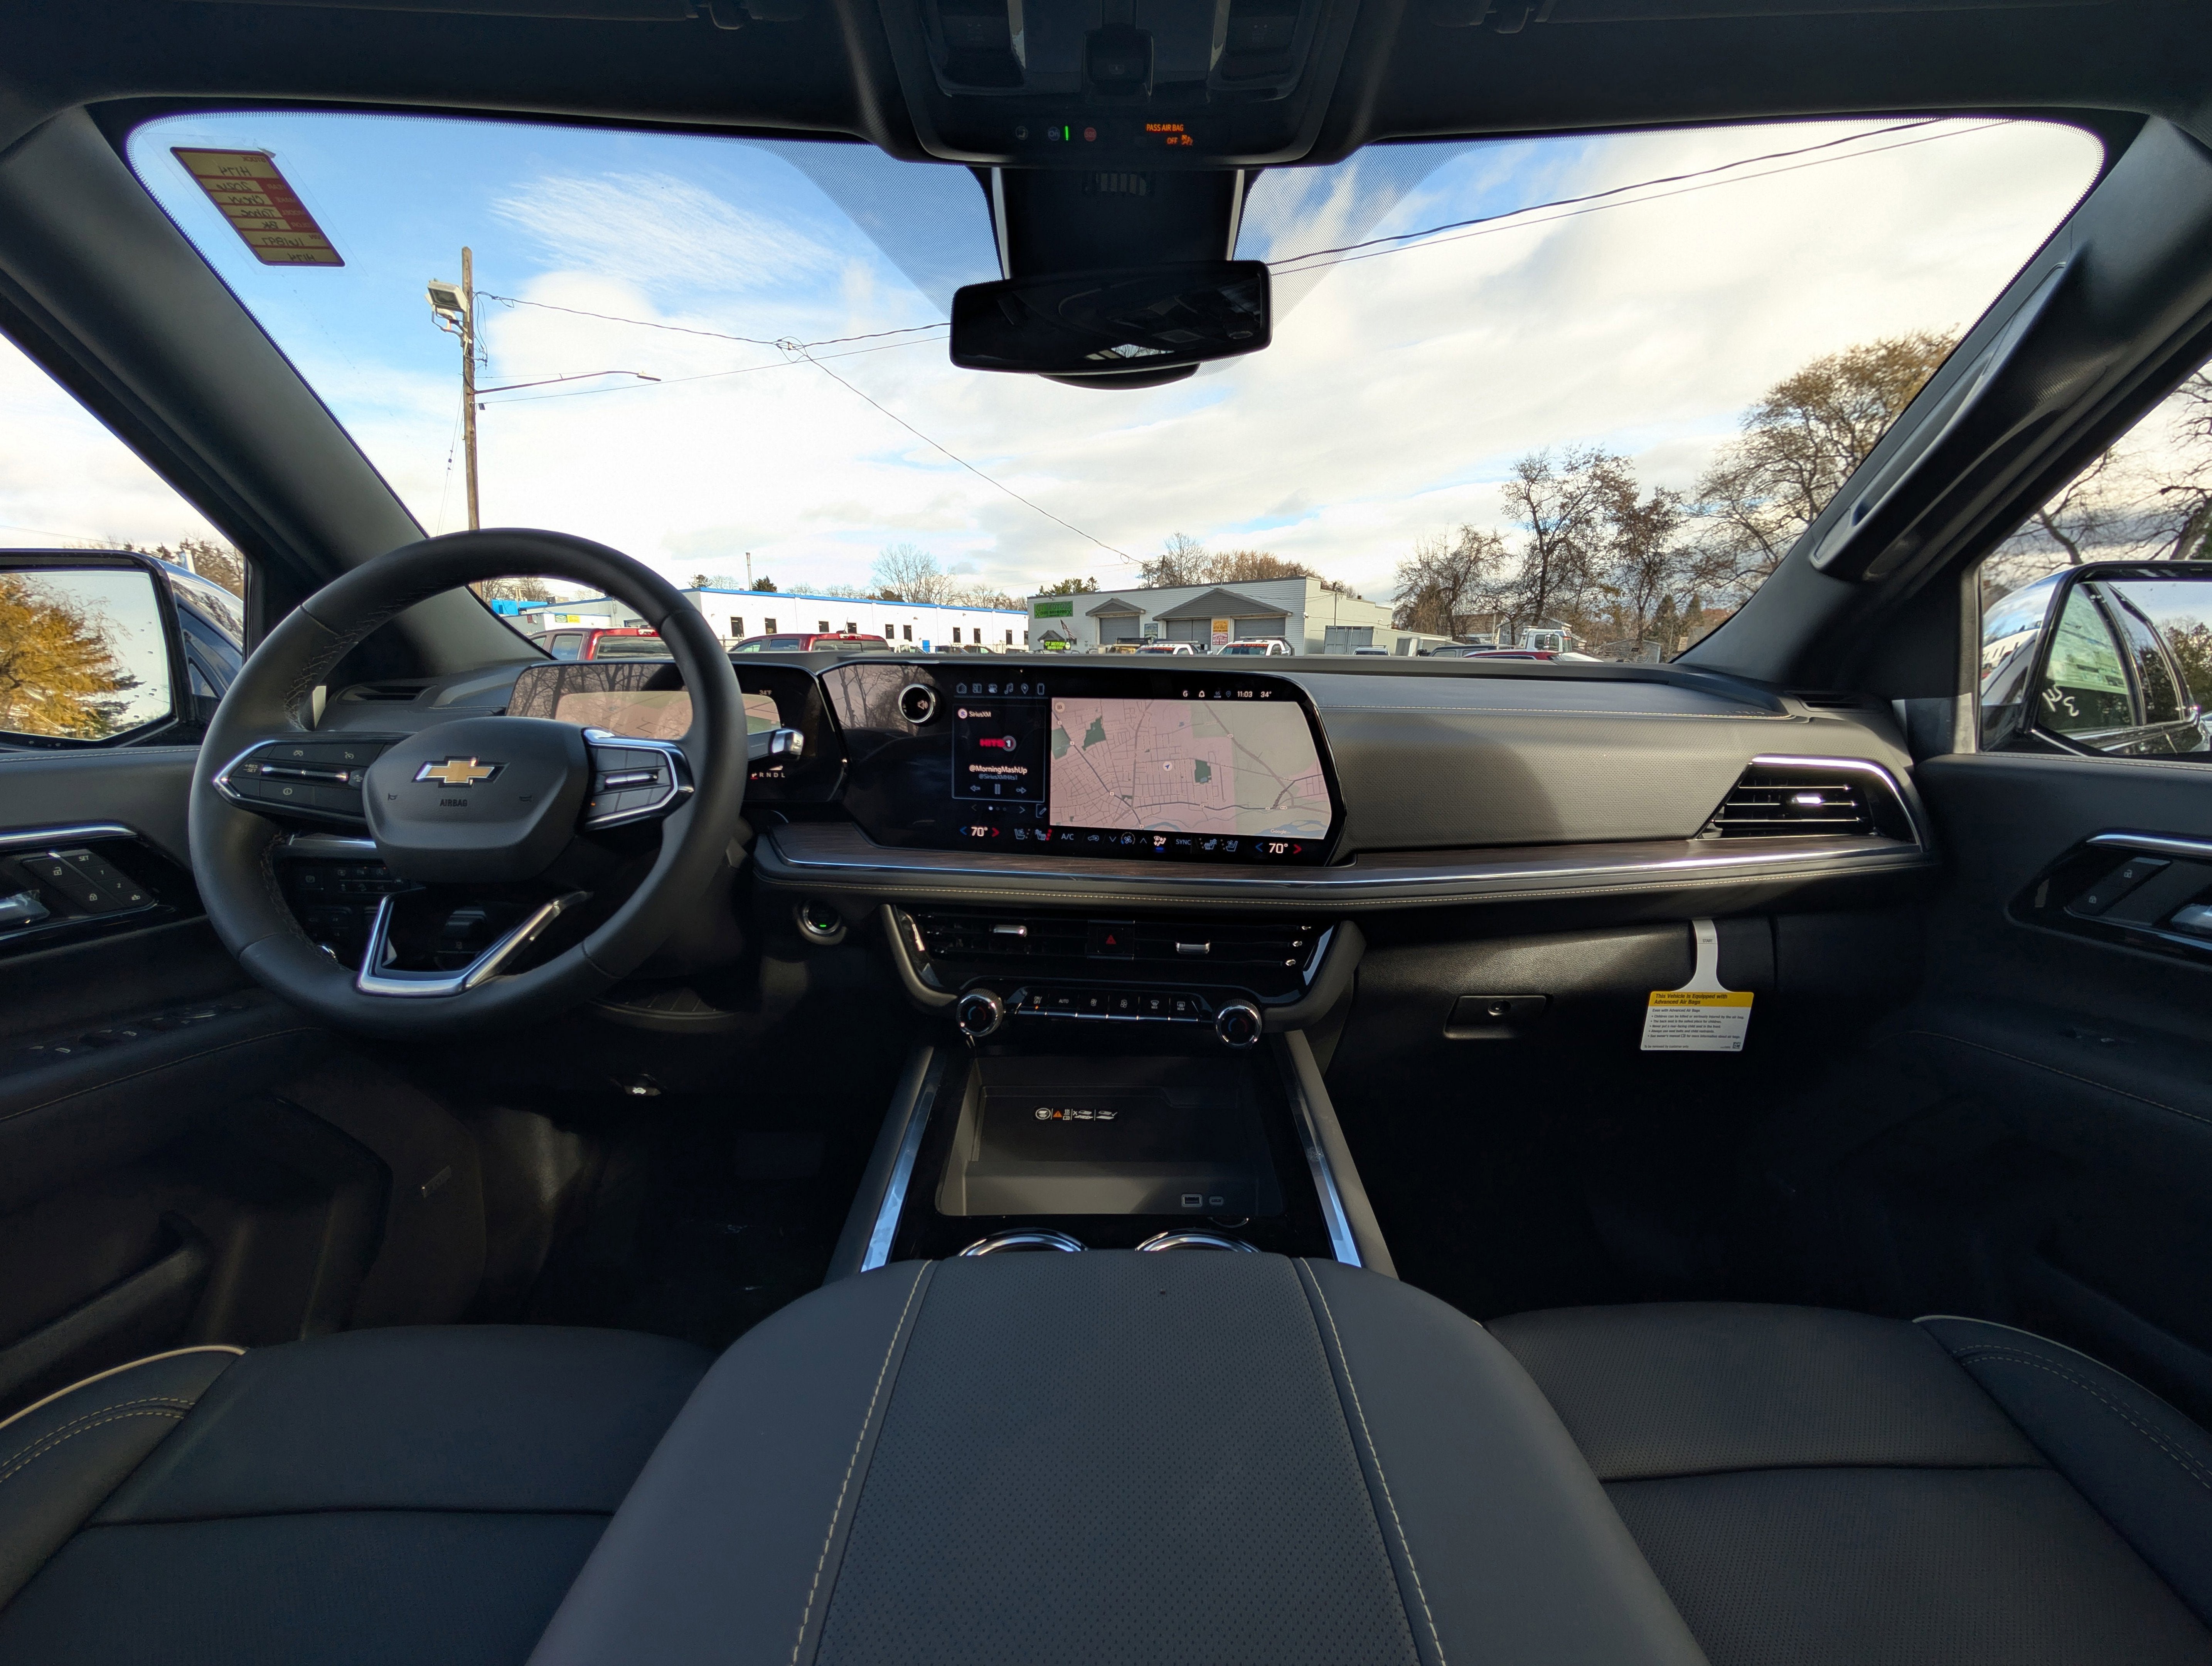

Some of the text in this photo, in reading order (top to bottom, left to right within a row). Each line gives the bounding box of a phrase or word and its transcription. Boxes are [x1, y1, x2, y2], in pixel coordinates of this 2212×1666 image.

[969, 764, 1028, 775] @MorningMashUp
[971, 826, 988, 837] 70°
[1269, 843, 1289, 854] 70°
